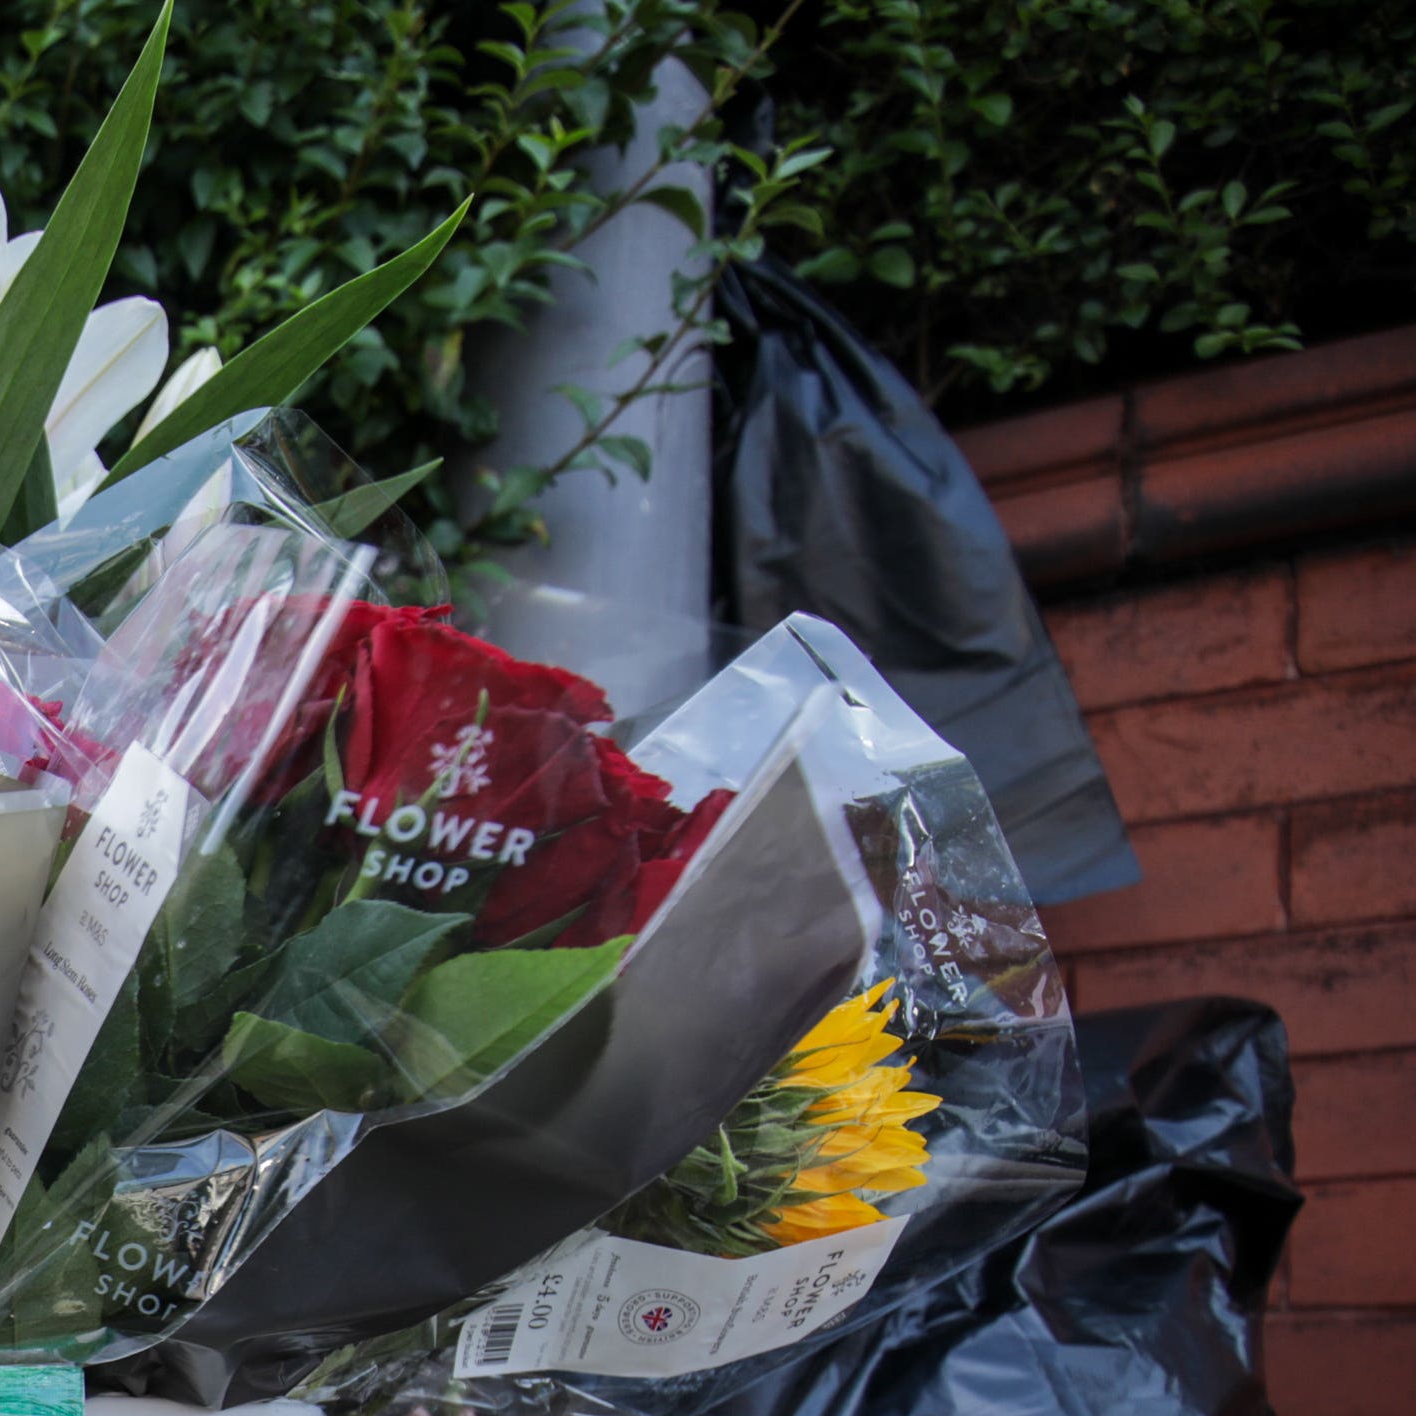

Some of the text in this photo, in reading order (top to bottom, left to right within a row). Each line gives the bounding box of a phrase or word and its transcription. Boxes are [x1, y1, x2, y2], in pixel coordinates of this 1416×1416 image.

[324, 789, 535, 867] FLOWER
[94, 870, 130, 909] SHOP
[95, 826, 159, 897] FLOWER
[360, 849, 470, 894] SHOP
[899, 909, 935, 977] SHOP
[527, 1273, 564, 1330] £4.00
[780, 1276, 810, 1318] SHOP
[786, 1249, 845, 1331] FLOWER
